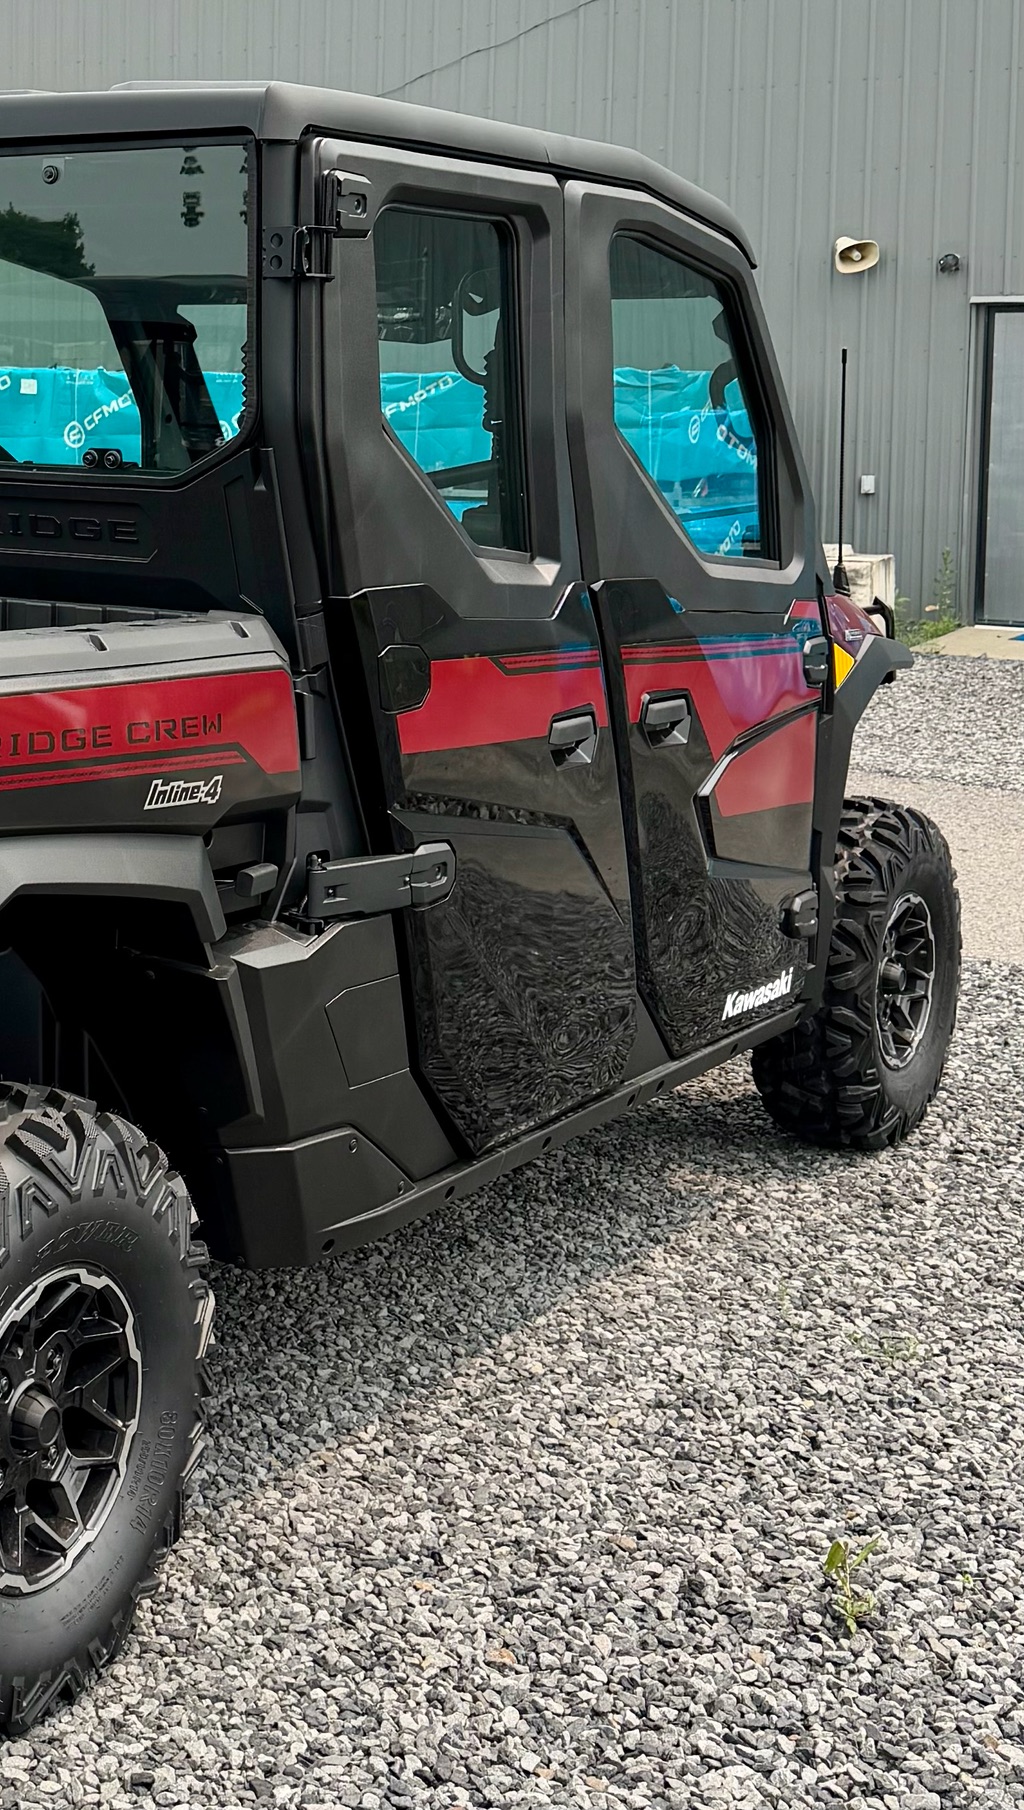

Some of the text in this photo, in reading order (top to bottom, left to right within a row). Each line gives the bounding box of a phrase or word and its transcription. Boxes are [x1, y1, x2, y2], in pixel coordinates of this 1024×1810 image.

[84, 388, 133, 430] CFMO
[126, 713, 223, 745] CREW
[143, 774, 224, 811] Inline-4
[721, 966, 794, 1021] Kawasaki
